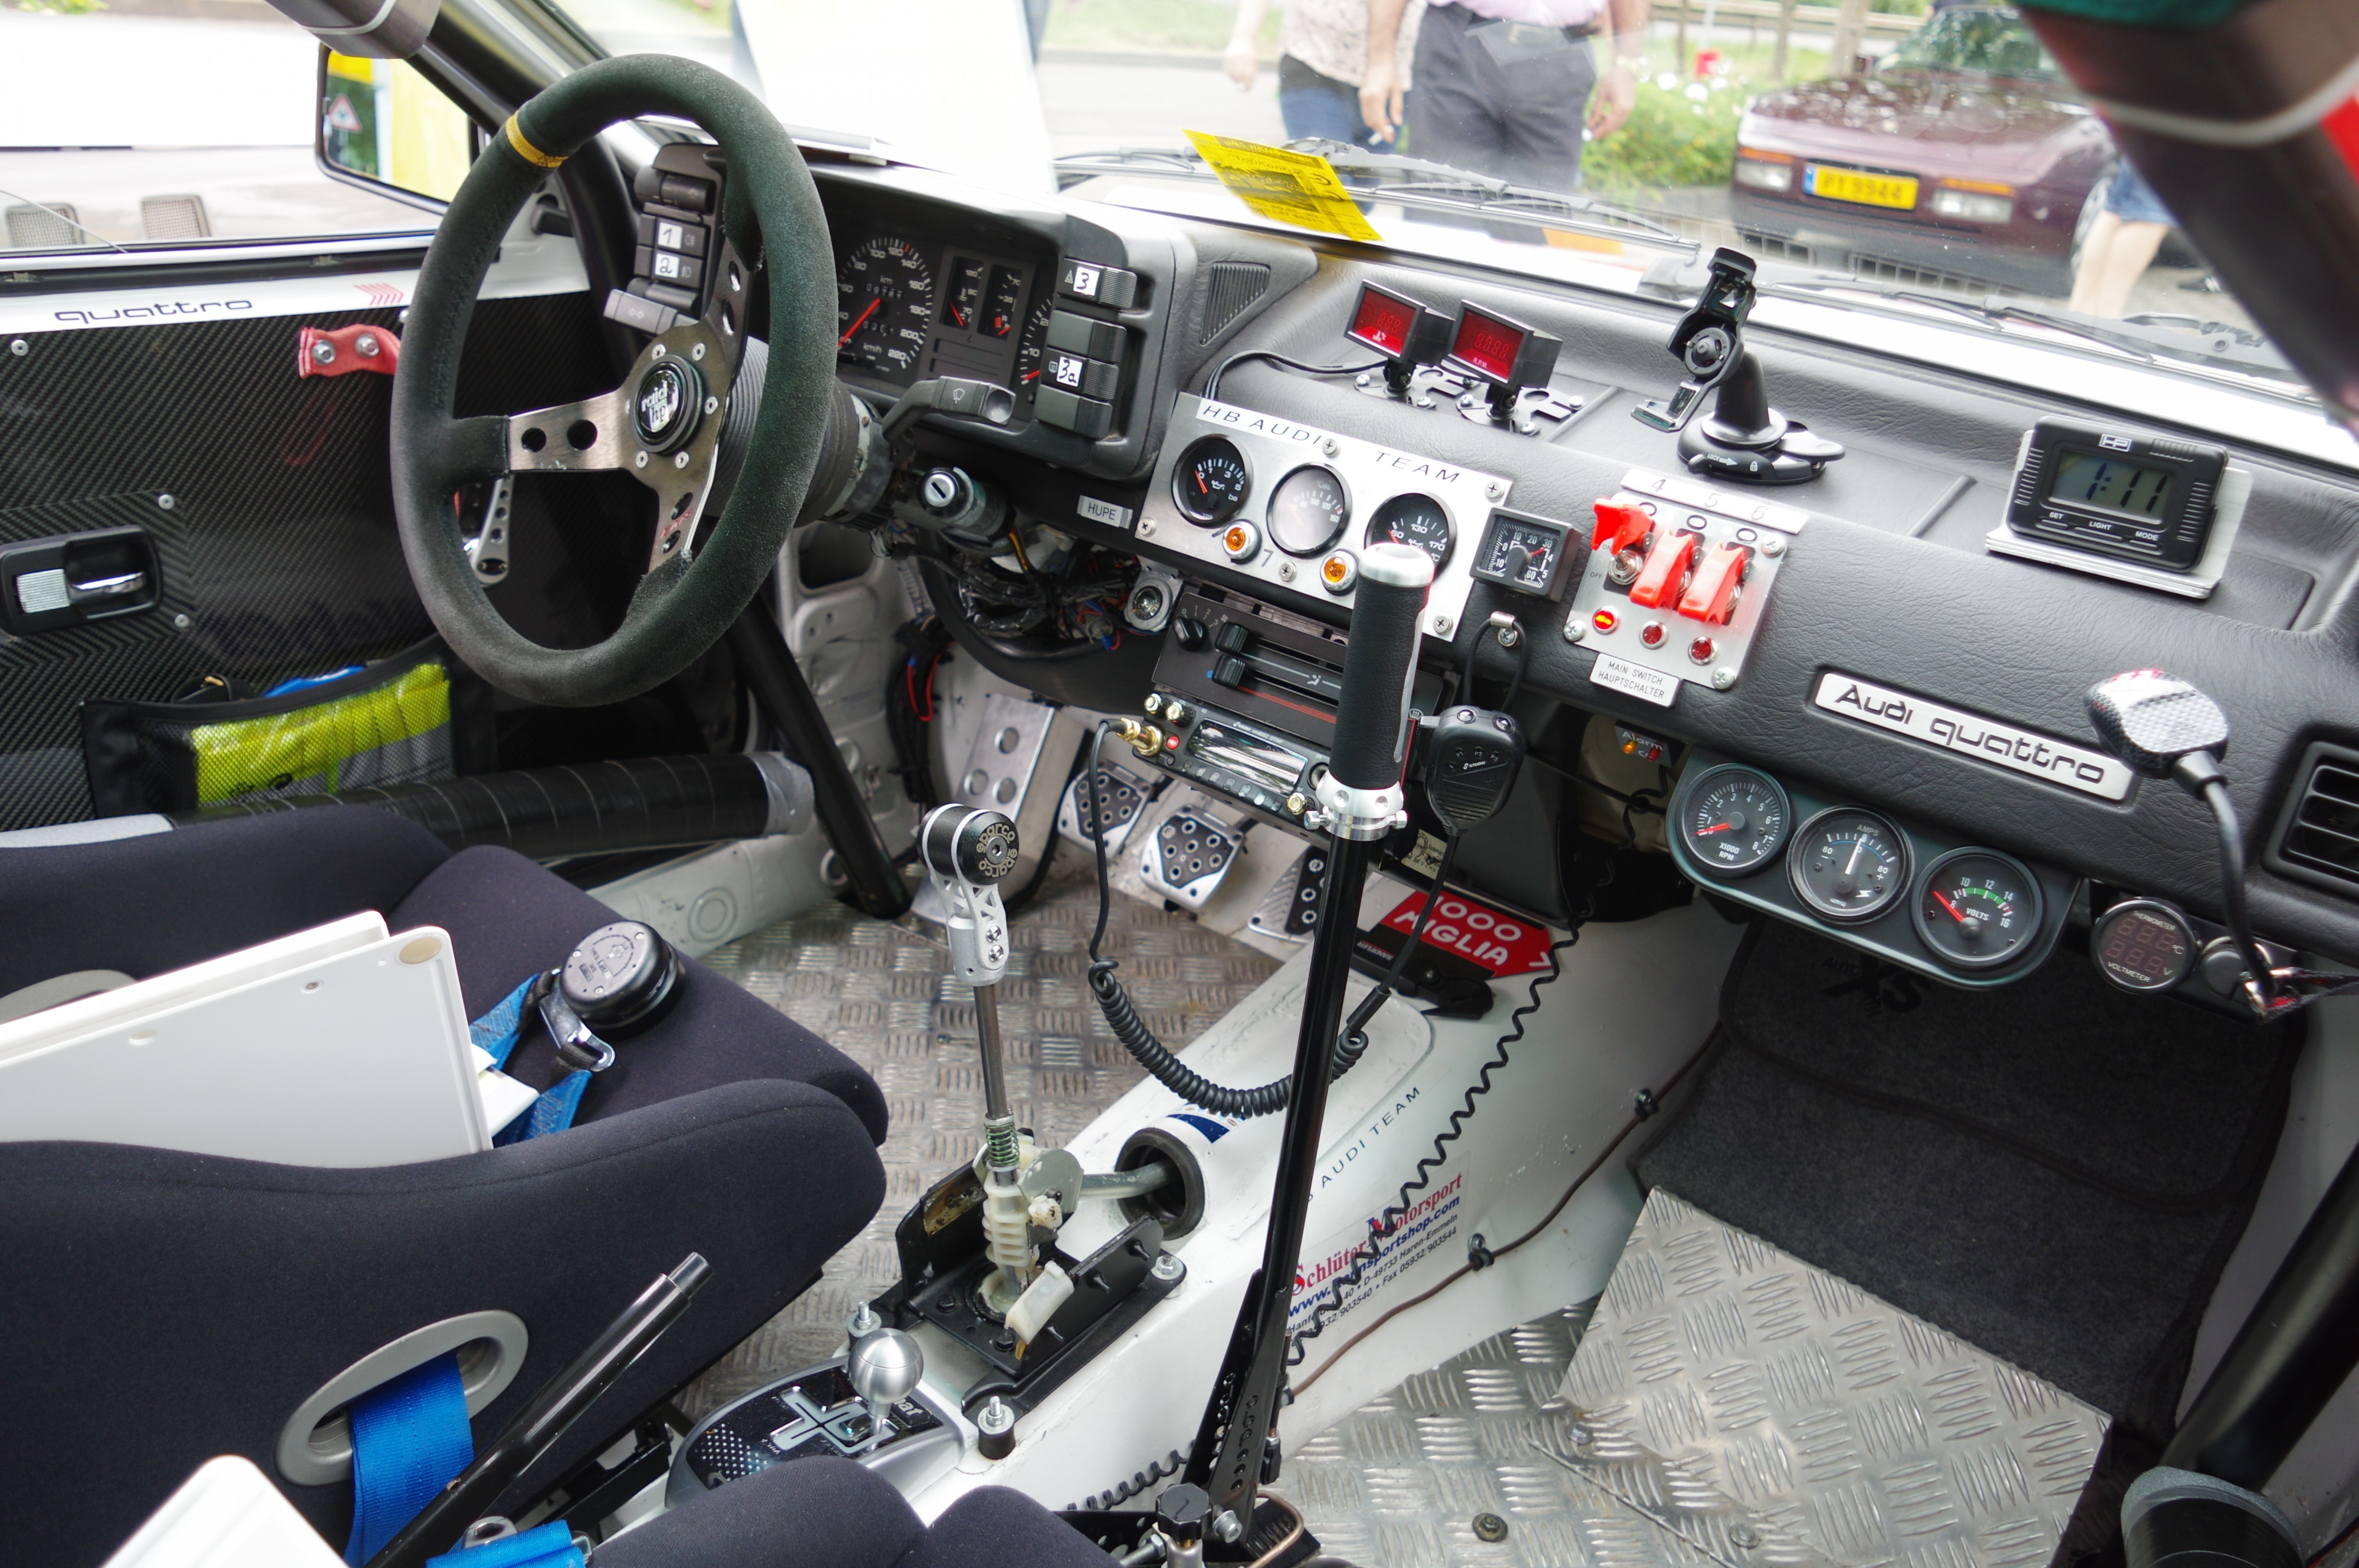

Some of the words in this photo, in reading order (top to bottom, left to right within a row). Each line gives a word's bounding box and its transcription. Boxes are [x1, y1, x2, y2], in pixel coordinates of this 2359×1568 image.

[662, 226, 674, 245] 1
[870, 249, 886, 259] 100
[888, 246, 903, 257] 120
[658, 258, 673, 275] 2
[901, 259, 917, 269] 140
[880, 275, 892, 284] km
[1076, 272, 1089, 291] 3
[908, 280, 925, 291] 160
[54, 300, 252, 324] quattro
[909, 305, 926, 315] 180
[900, 328, 919, 340] 200
[863, 342, 882, 354] km/h
[1029, 347, 1040, 357] 10
[888, 349, 907, 361] 220
[1059, 359, 1077, 384] 3a
[640, 378, 668, 412] raid
[651, 405, 666, 423] hp
[1203, 405, 1241, 423] HB
[1249, 419, 1322, 445] AUDI
[1374, 450, 1461, 484] TEAM
[1707, 453, 1720, 462] LOCK
[1651, 478, 1667, 494] 4
[2085, 462, 2168, 513] 1:11
[1704, 492, 1723, 508] 5
[1087, 502, 1117, 521] HUPE
[1751, 504, 1769, 521] 6
[2049, 511, 2065, 521] SET
[1410, 523, 1428, 534] 130
[2089, 520, 2113, 531] LIGHT
[1513, 532, 1522, 541] 10
[1527, 535, 1537, 544] 20
[2135, 531, 2158, 541] MODE
[1428, 540, 1445, 551] 170
[1502, 543, 1508, 551] 0
[1543, 539, 1552, 548] 30
[1260, 548, 1274, 568] 7
[1526, 570, 1536, 580] 60
[1590, 571, 1602, 580] OFF
[1608, 660, 1628, 676] MAIN
[1632, 668, 1663, 686] SWITCH
[1598, 671, 1665, 700] HAUPTSCHALTER
[1269, 735, 1284, 744] DTMF
[1835, 684, 1913, 725] Audi
[1929, 717, 2105, 784] quattro
[1622, 731, 1663, 751] Alarm
[1730, 793, 1736, 801] 3
[1746, 794, 1752, 803] 4
[1717, 799, 1723, 808] 2
[1758, 803, 1765, 812] 5
[1707, 816, 1712, 824] 1
[1765, 816, 1772, 825] 6
[1857, 824, 1880, 837] AMPS
[976, 823, 1016, 854] sparco
[1762, 835, 1769, 844] 7
[1719, 842, 1740, 854] X1000
[1752, 841, 1759, 850] 8
[1822, 845, 1833, 854] 80
[1719, 851, 1734, 862] RPM
[978, 847, 1018, 878] sparco
[1877, 865, 1888, 874] 80
[1960, 876, 1970, 887] 10
[1985, 879, 1995, 890] 12
[2003, 891, 2014, 902] 14
[1950, 900, 1956, 909] 8
[1966, 907, 1990, 921] VOLTS
[2000, 918, 2011, 928] 16
[2133, 910, 2176, 932] THERMOMETER
[2173, 944, 2184, 955] °C
[1822, 956, 1860, 976] AUTO
[2108, 961, 2150, 983] VOLTMETER
[1320, 1139, 1366, 1188] AUDI
[1369, 1086, 1421, 1136] TEAM
[1292, 1240, 1367, 1296] Schlüter
[1366, 1172, 1463, 1242] Motorsport
[1364, 1256, 1398, 1287] D-49733
[1399, 1213, 1458, 1260] Haren-Emmeln
[1382, 1271, 1398, 1287] Fax
[1400, 1226, 1457, 1273] 05932/903544
